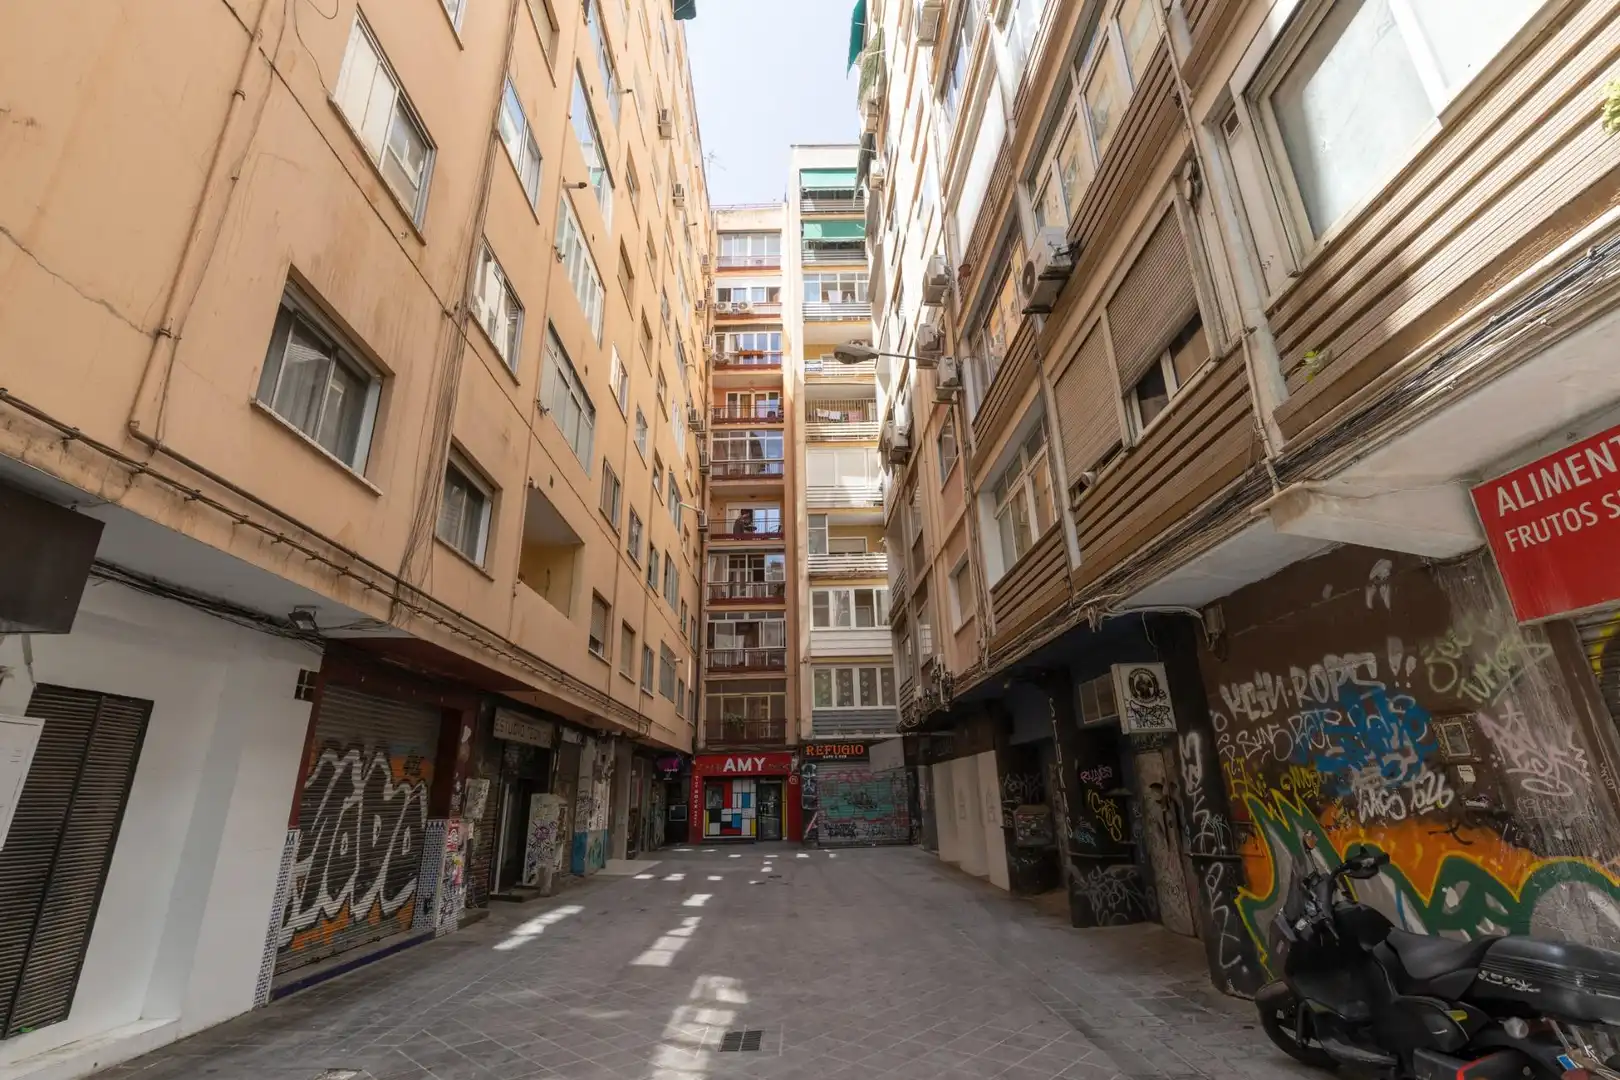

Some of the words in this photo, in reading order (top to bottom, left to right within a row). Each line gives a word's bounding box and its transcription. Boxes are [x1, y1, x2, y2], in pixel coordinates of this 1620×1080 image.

[1504, 501, 1598, 552] FRUTOS
[1601, 489, 1620, 519] S
[805, 744, 864, 757] REFUGIO
[722, 756, 767, 772] AMY
